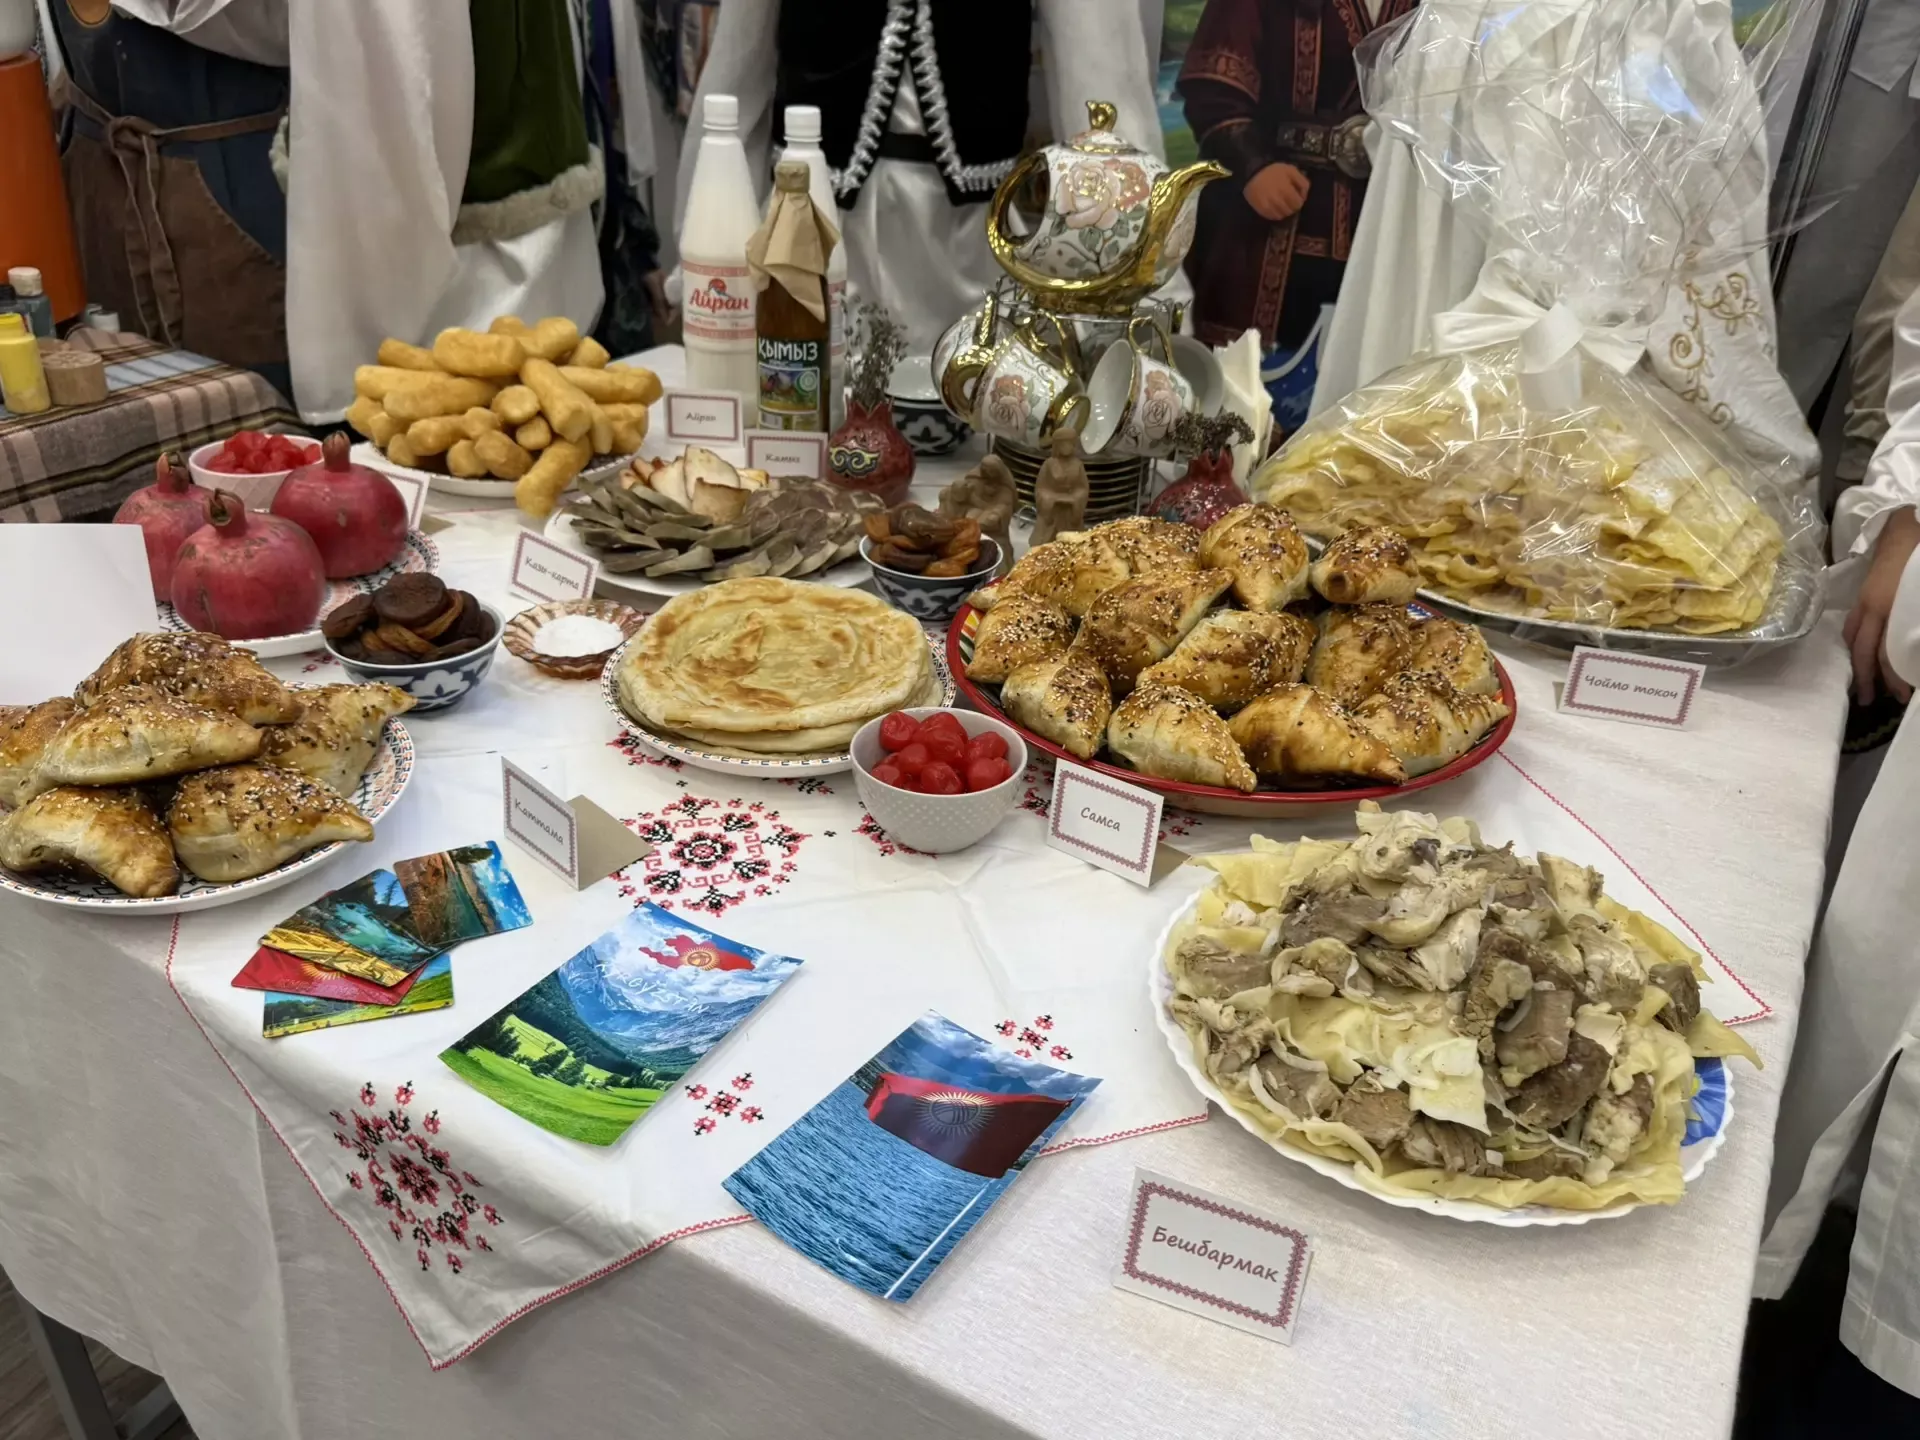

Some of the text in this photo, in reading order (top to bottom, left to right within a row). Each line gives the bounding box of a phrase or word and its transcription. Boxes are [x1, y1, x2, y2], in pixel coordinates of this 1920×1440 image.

[689, 288, 749, 314] Айран
[1584, 674, 1678, 700] Чоймо токоч
[514, 798, 564, 846] Каттама
[1080, 806, 1121, 832] Самса
[1151, 1225, 1279, 1283] Бешбармак
